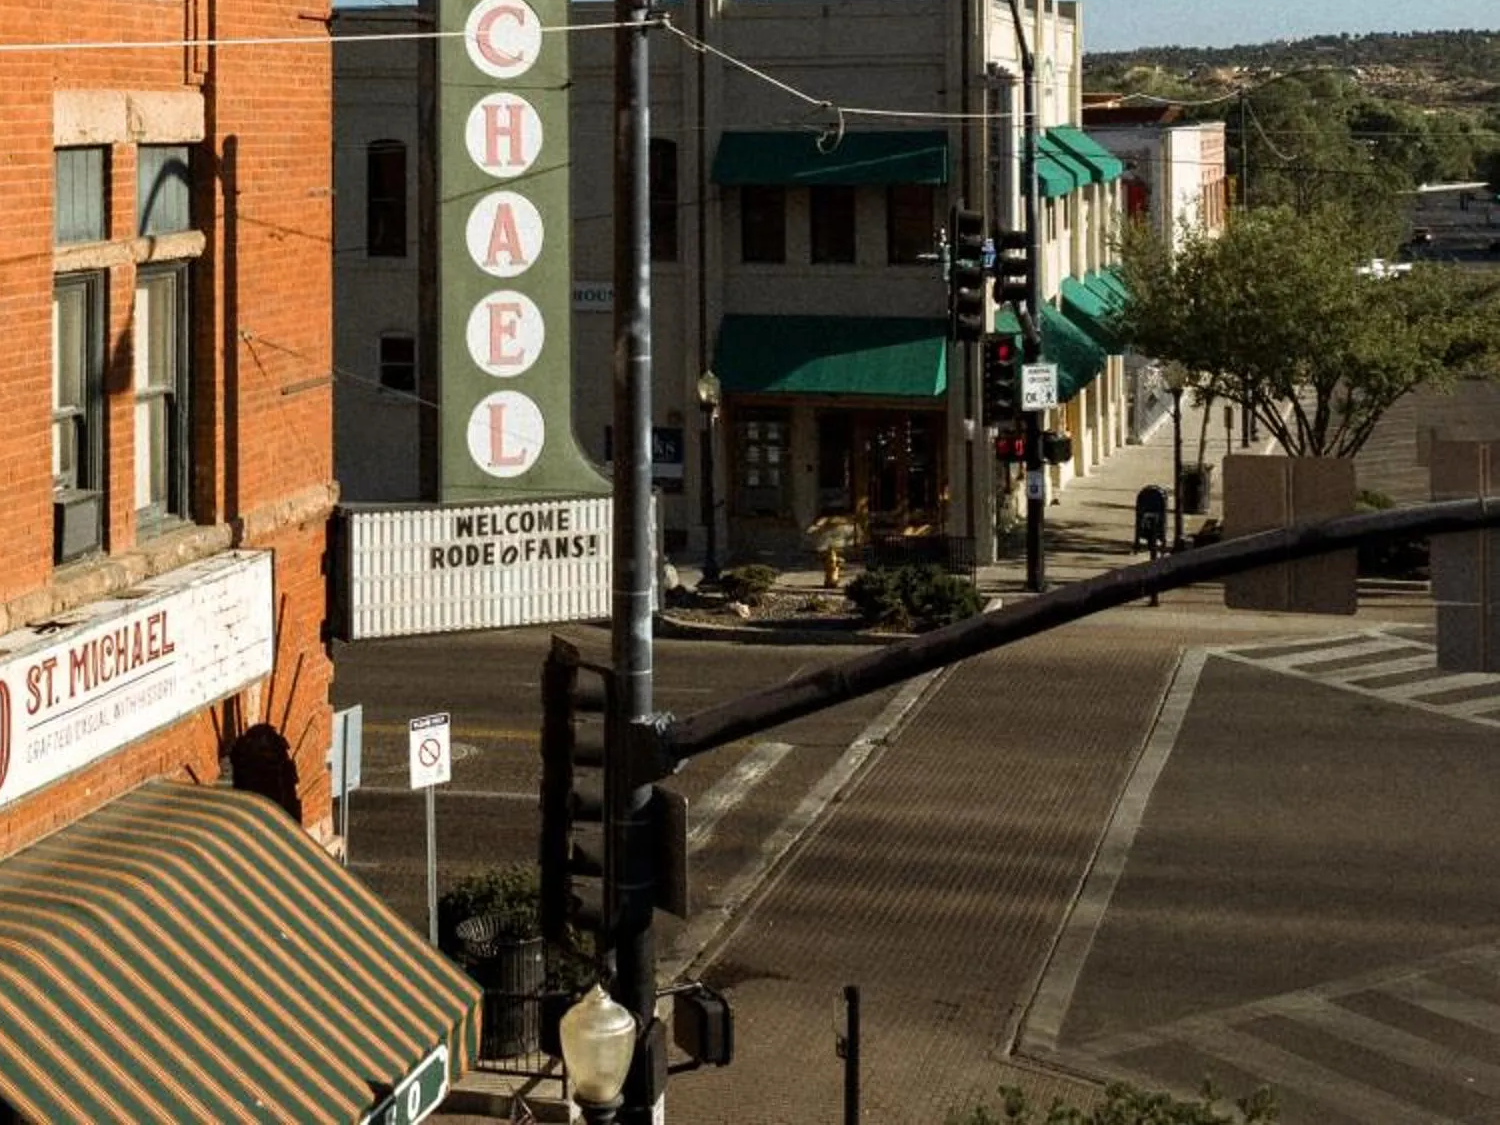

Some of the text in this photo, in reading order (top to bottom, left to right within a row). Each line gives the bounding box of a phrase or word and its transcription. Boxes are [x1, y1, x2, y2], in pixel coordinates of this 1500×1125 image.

[456, 508, 570, 538] WELCOME
[431, 534, 597, 569] RODEO FANS!
[26, 656, 60, 715] ST.
[69, 610, 175, 698] MICHAEL
